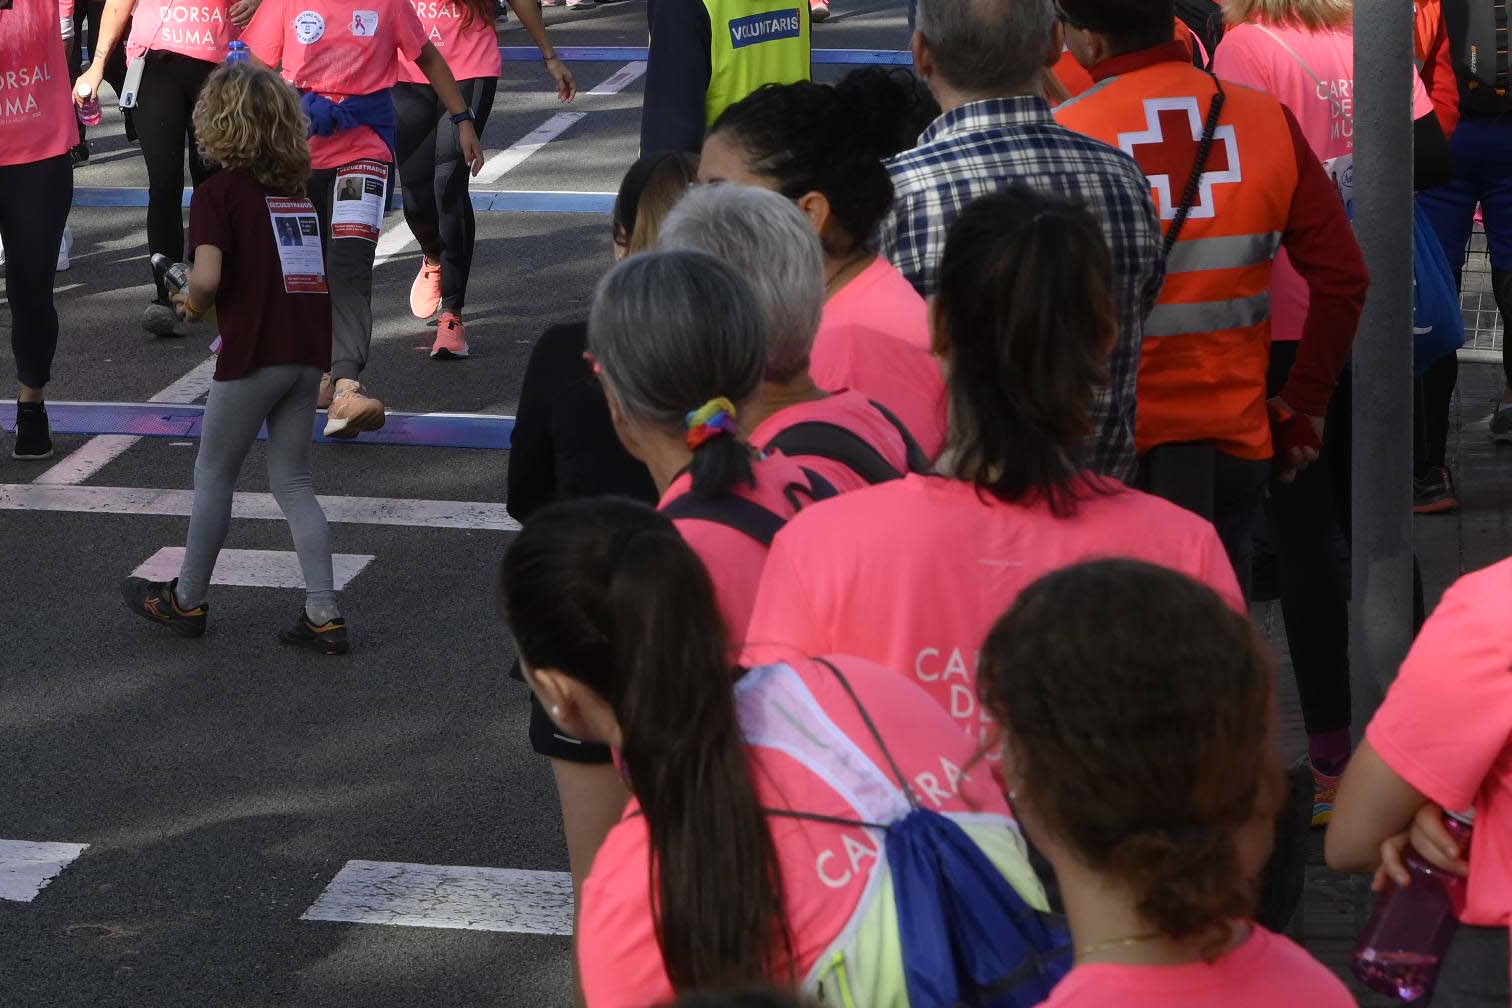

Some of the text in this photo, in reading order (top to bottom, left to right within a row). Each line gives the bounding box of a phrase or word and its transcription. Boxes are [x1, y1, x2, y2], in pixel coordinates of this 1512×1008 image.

[410, 0, 461, 19] RSAL
[161, 27, 216, 45] SUMA
[732, 16, 799, 41] VOLUNTARIS
[1316, 79, 1353, 101] CAR
[1331, 121, 1353, 140] MU
[915, 647, 982, 683] CA
